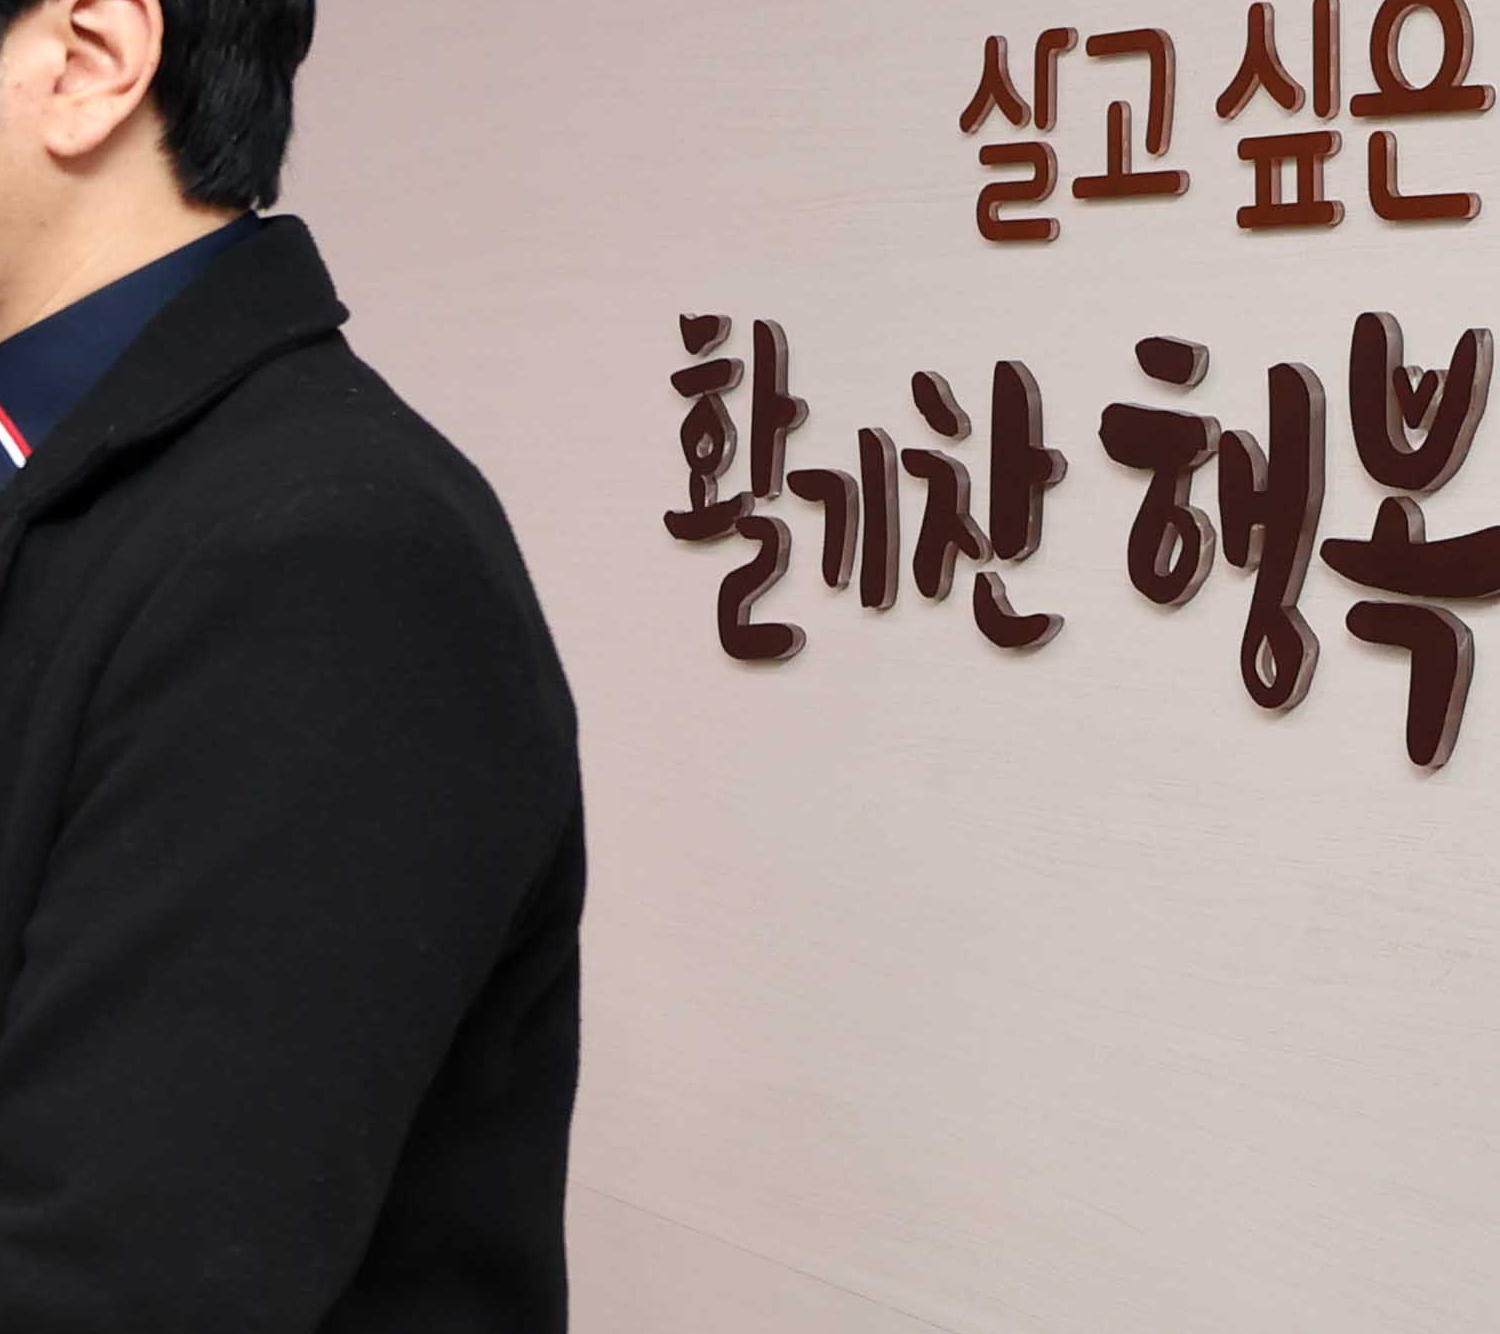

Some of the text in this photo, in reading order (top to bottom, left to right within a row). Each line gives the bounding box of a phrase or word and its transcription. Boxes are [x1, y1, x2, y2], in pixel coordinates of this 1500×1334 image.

[960, 27, 1190, 240] 살고
[664, 311, 1500, 768] 활기찬 행복
